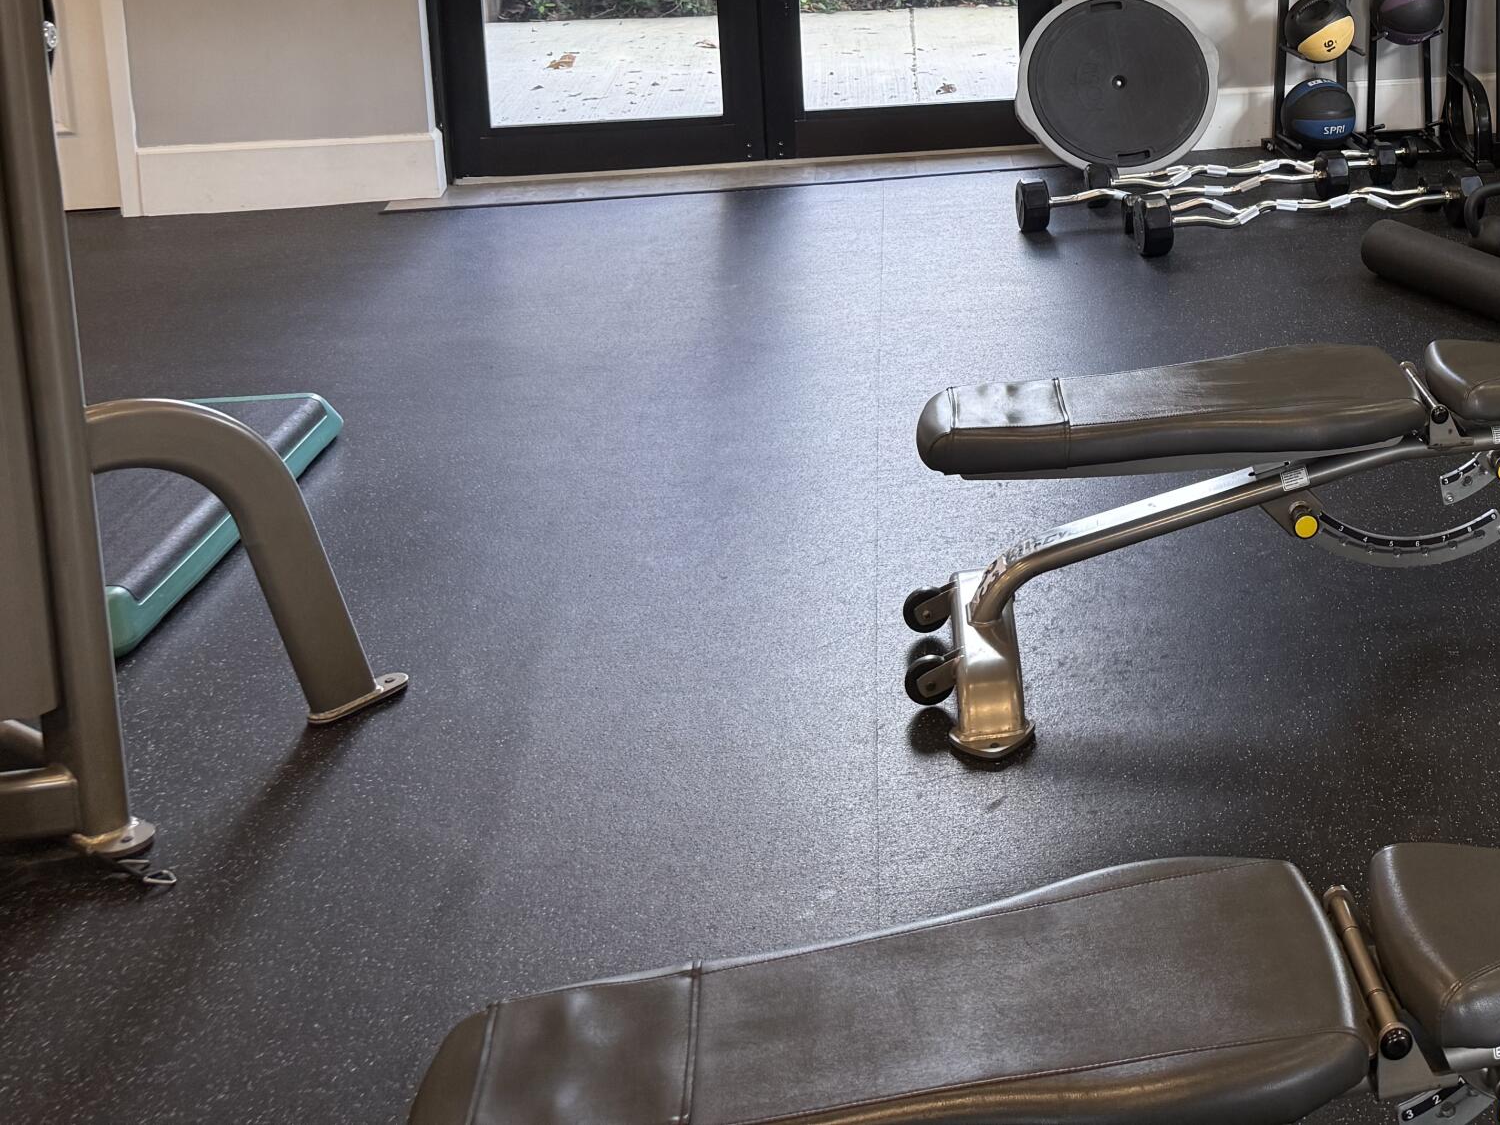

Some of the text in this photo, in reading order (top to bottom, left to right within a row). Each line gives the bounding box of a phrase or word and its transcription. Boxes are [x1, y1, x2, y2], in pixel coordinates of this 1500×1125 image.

[1324, 39, 1335, 53] 16
[1323, 124, 1345, 135] SPRI
[1432, 1094, 1442, 1105] 2
[1406, 1109, 1414, 1119] 3
